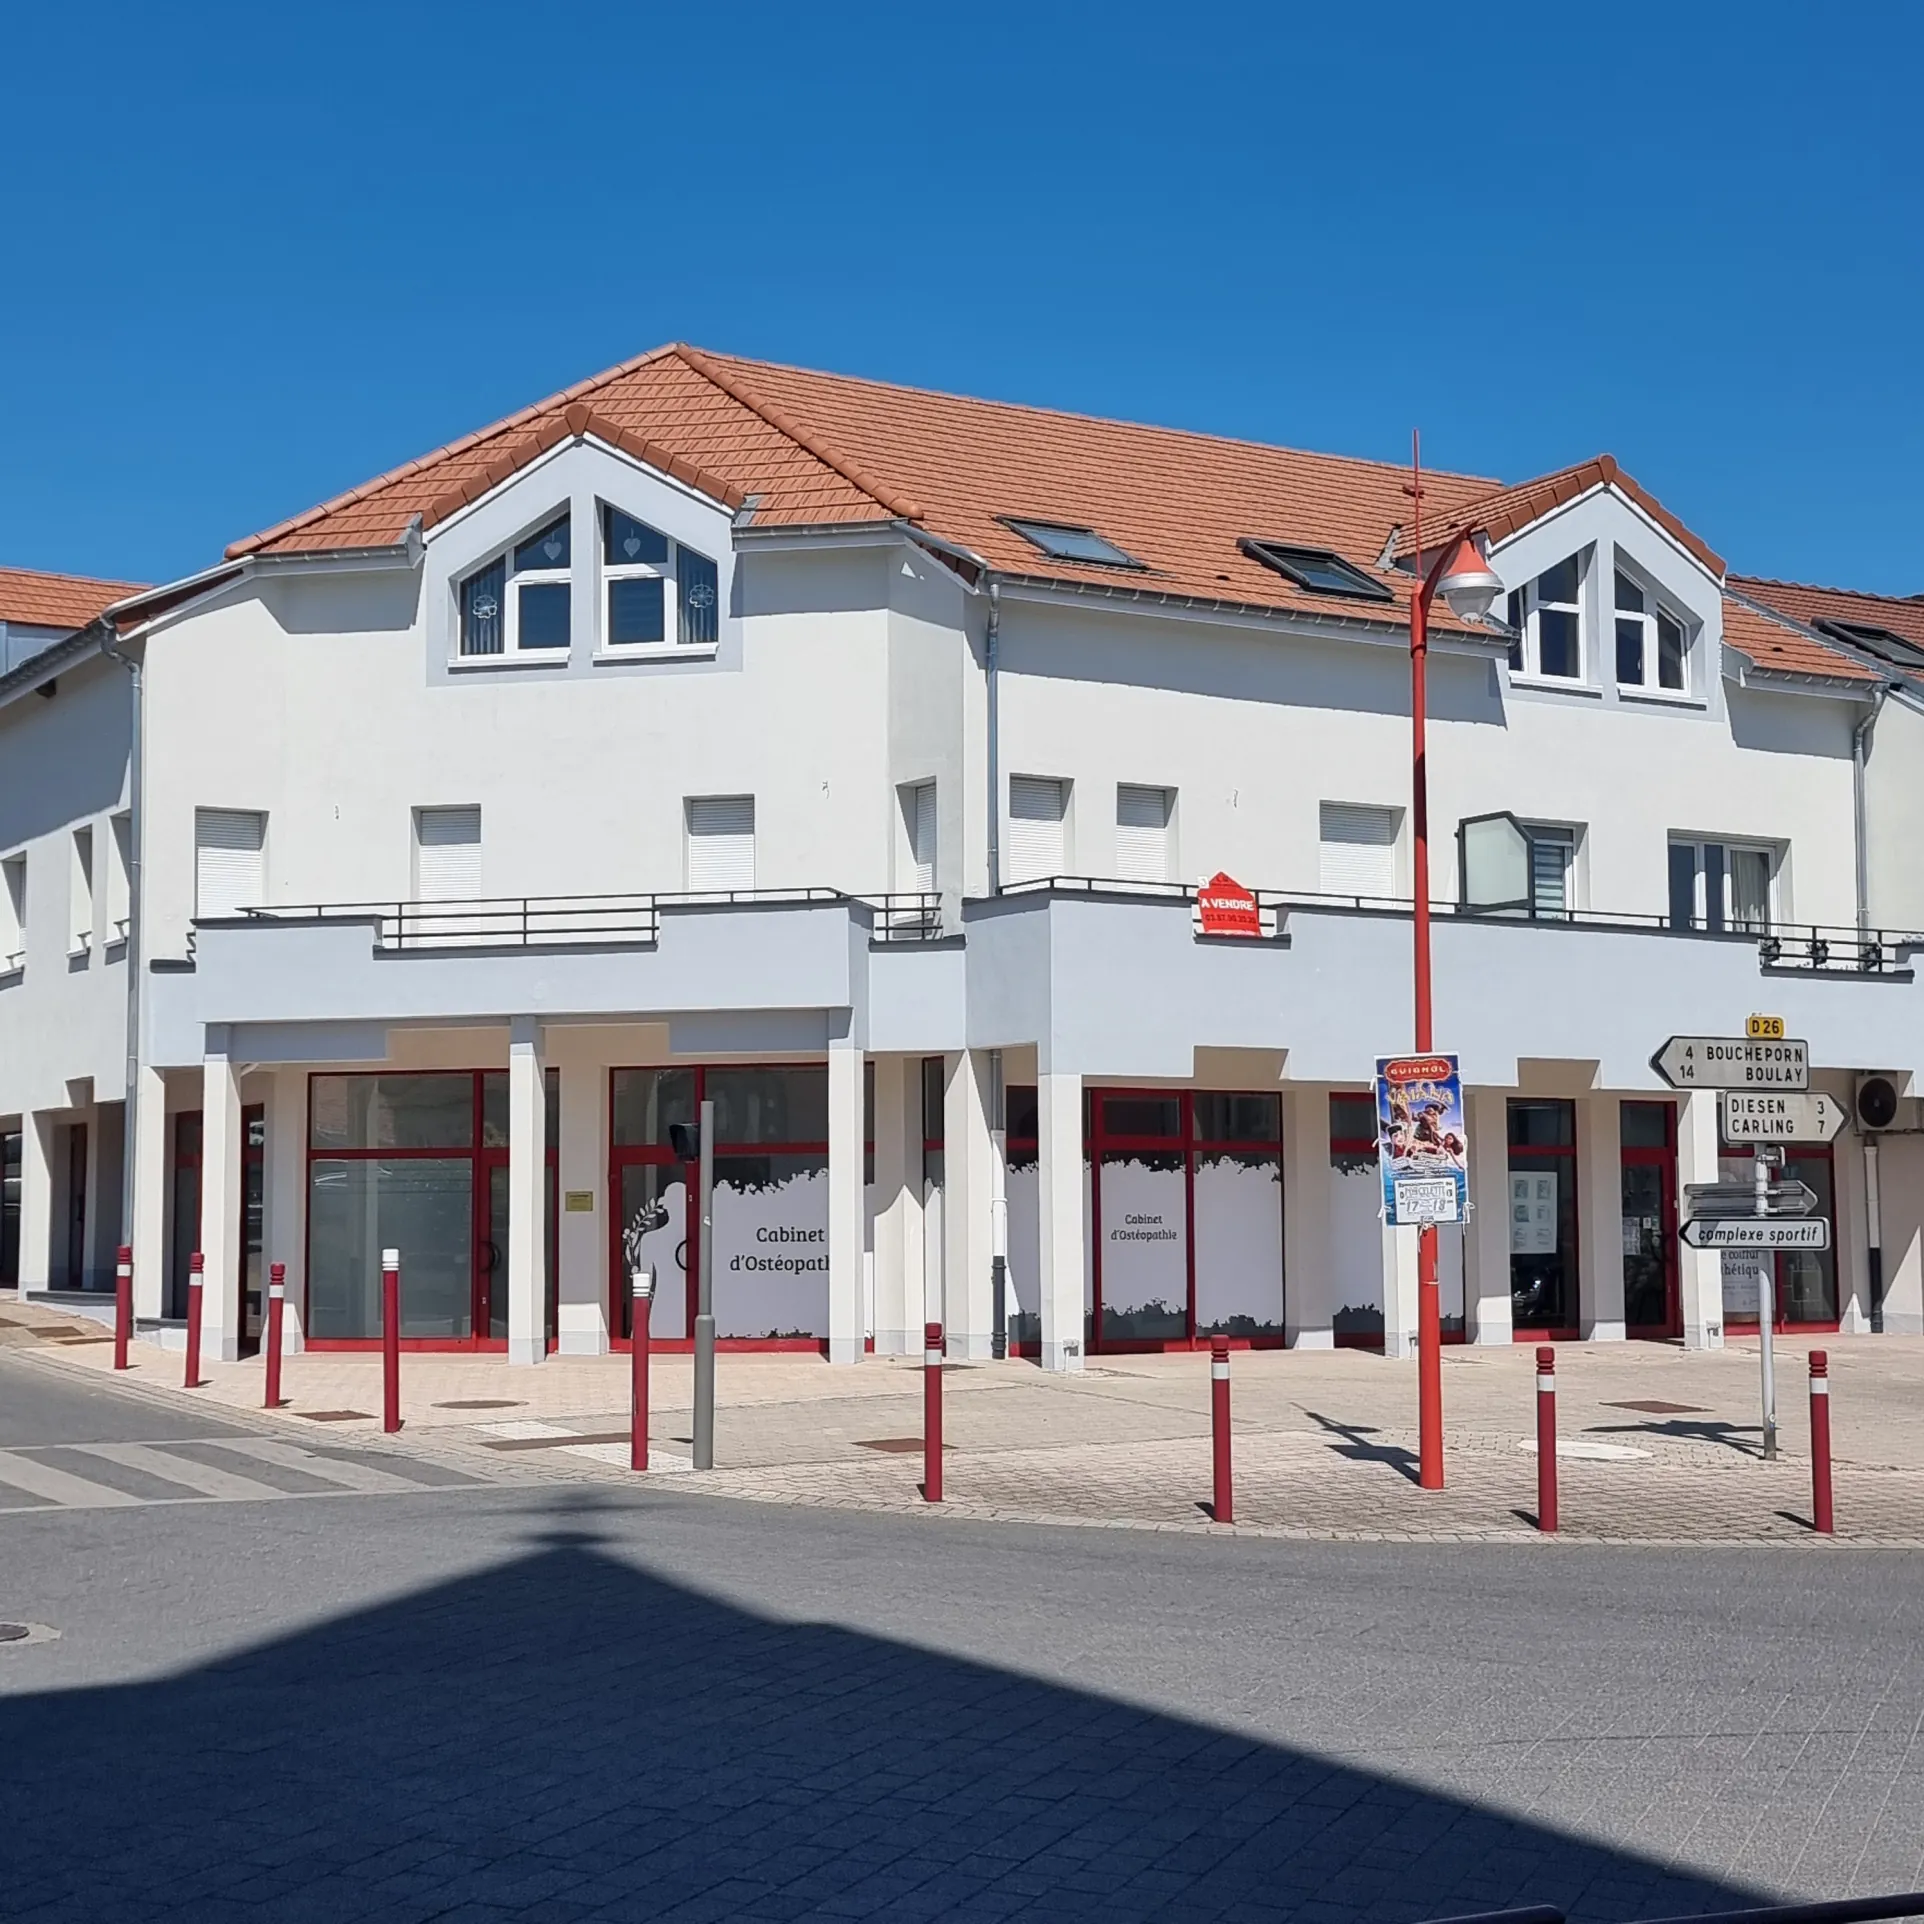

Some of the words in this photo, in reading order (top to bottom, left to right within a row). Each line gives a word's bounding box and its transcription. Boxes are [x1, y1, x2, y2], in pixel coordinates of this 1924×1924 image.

[1201, 897, 1211, 908] A
[1211, 898, 1255, 911] VENDRE
[1752, 1019, 1760, 1033] D
[1763, 1020, 1780, 1034] 26
[1685, 1045, 1694, 1060] 4
[1706, 1046, 1803, 1063] BOUCHEPORN
[1679, 1064, 1694, 1079] 14
[1745, 1066, 1803, 1082] BOULAY
[1731, 1098, 1785, 1114] DIESEN
[1817, 1100, 1825, 1115] 3
[1732, 1119, 1794, 1134] CARLING
[1817, 1120, 1825, 1134] 7
[1124, 1213, 1163, 1225] Cabinet
[756, 1226, 825, 1243] Cabinet
[1110, 1229, 1178, 1243] d'Ostéopathie
[1698, 1227, 1764, 1244] complexe
[1769, 1226, 1819, 1244] sportif
